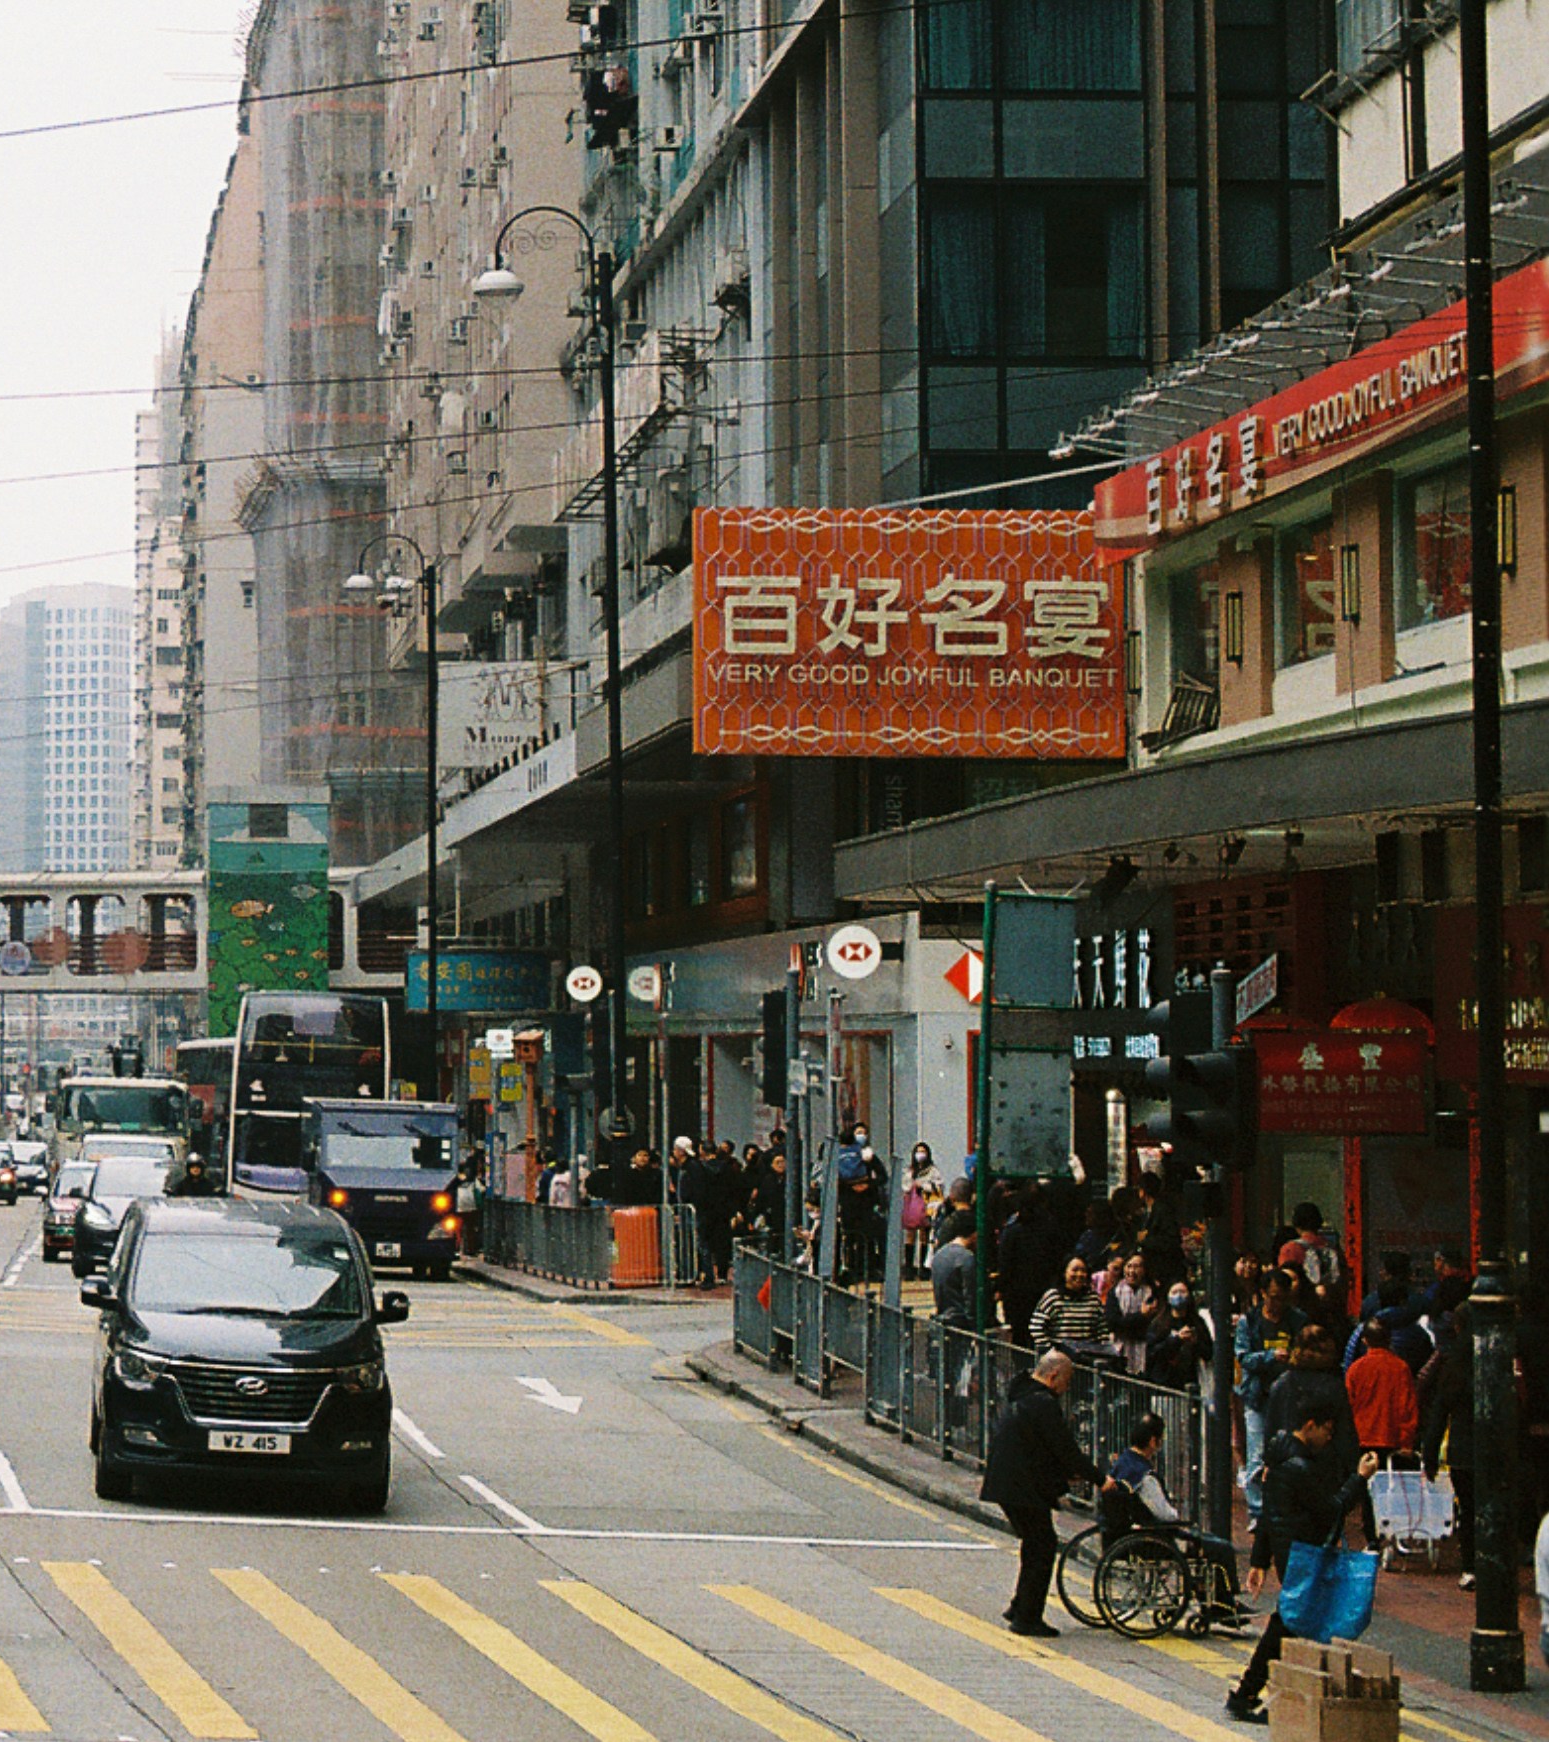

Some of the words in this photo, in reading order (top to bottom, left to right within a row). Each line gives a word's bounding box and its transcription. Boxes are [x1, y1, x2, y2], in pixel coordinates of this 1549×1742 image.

[1272, 411, 1303, 456] VERY
[1307, 392, 1344, 442] GOOD
[1345, 367, 1396, 426] JOYFUL
[1399, 330, 1468, 400] BANQUET
[1146, 412, 1264, 536] 百好名宴
[715, 573, 1111, 659] 百好名宴
[708, 663, 780, 684] VERY
[788, 664, 869, 686] GOOD
[876, 666, 979, 688] JOYFUL
[989, 667, 1118, 689] BANQUET
[252, 1436, 278, 1451] 415
